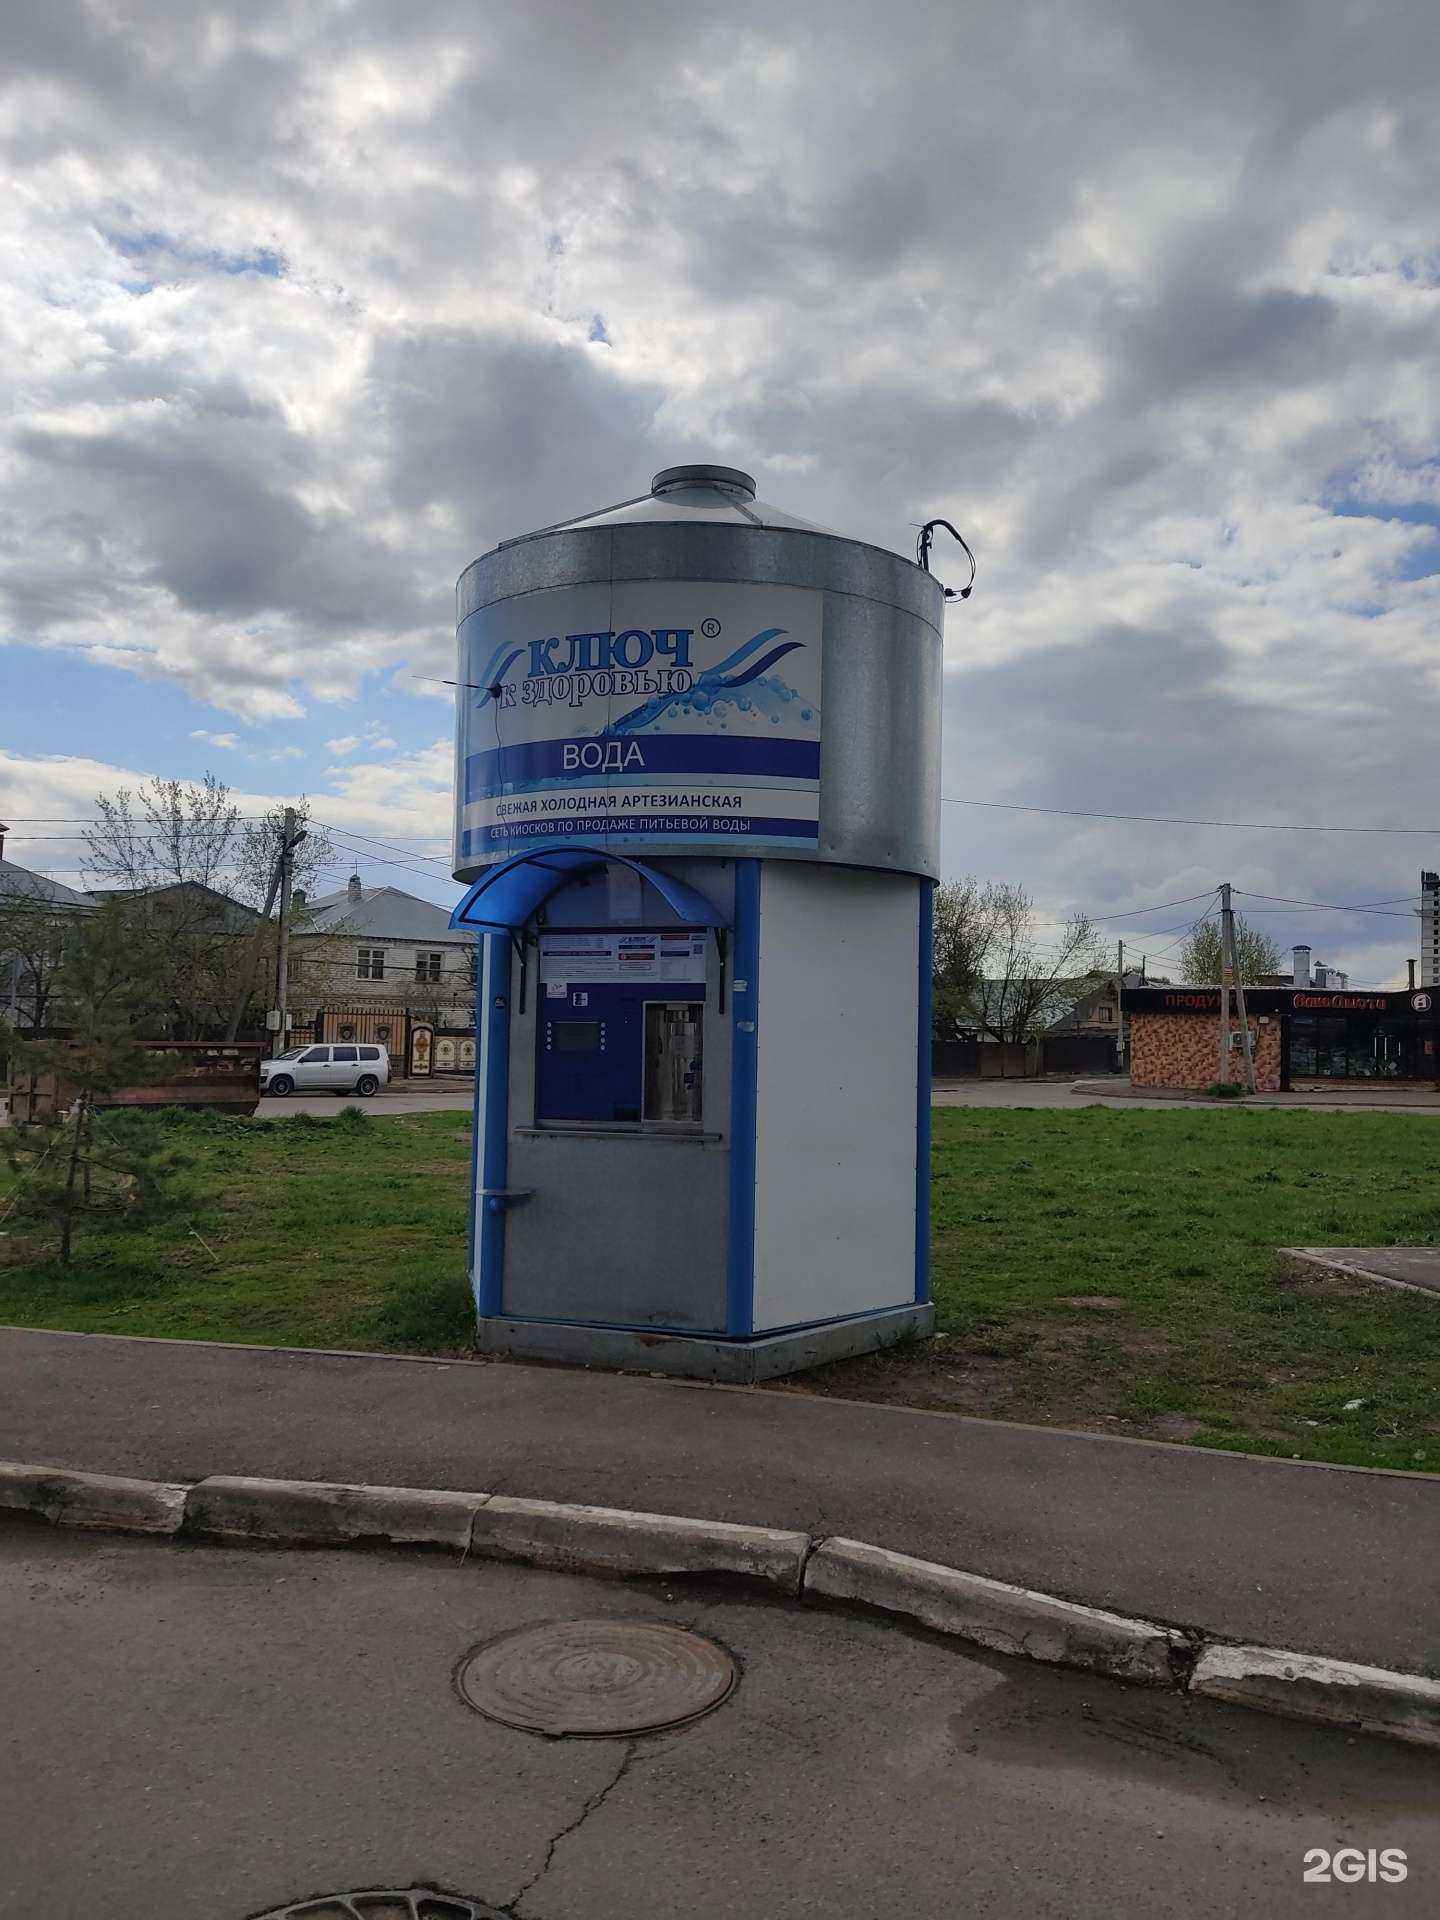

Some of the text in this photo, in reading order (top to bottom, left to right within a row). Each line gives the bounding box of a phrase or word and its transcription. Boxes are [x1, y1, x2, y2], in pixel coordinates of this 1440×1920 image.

[528, 629, 694, 678] КЛЮЧ
[563, 741, 645, 772] ВОДА
[496, 794, 742, 816] СВЕЖАЯ ХОЛОДНАЯ АРТЕЗИАНСКАЯ
[491, 816, 751, 839] СЕТЬ КИОСКОВ ПО ПРОДАЖЕ ПИТЬЕВОЙ ВОДЫ
